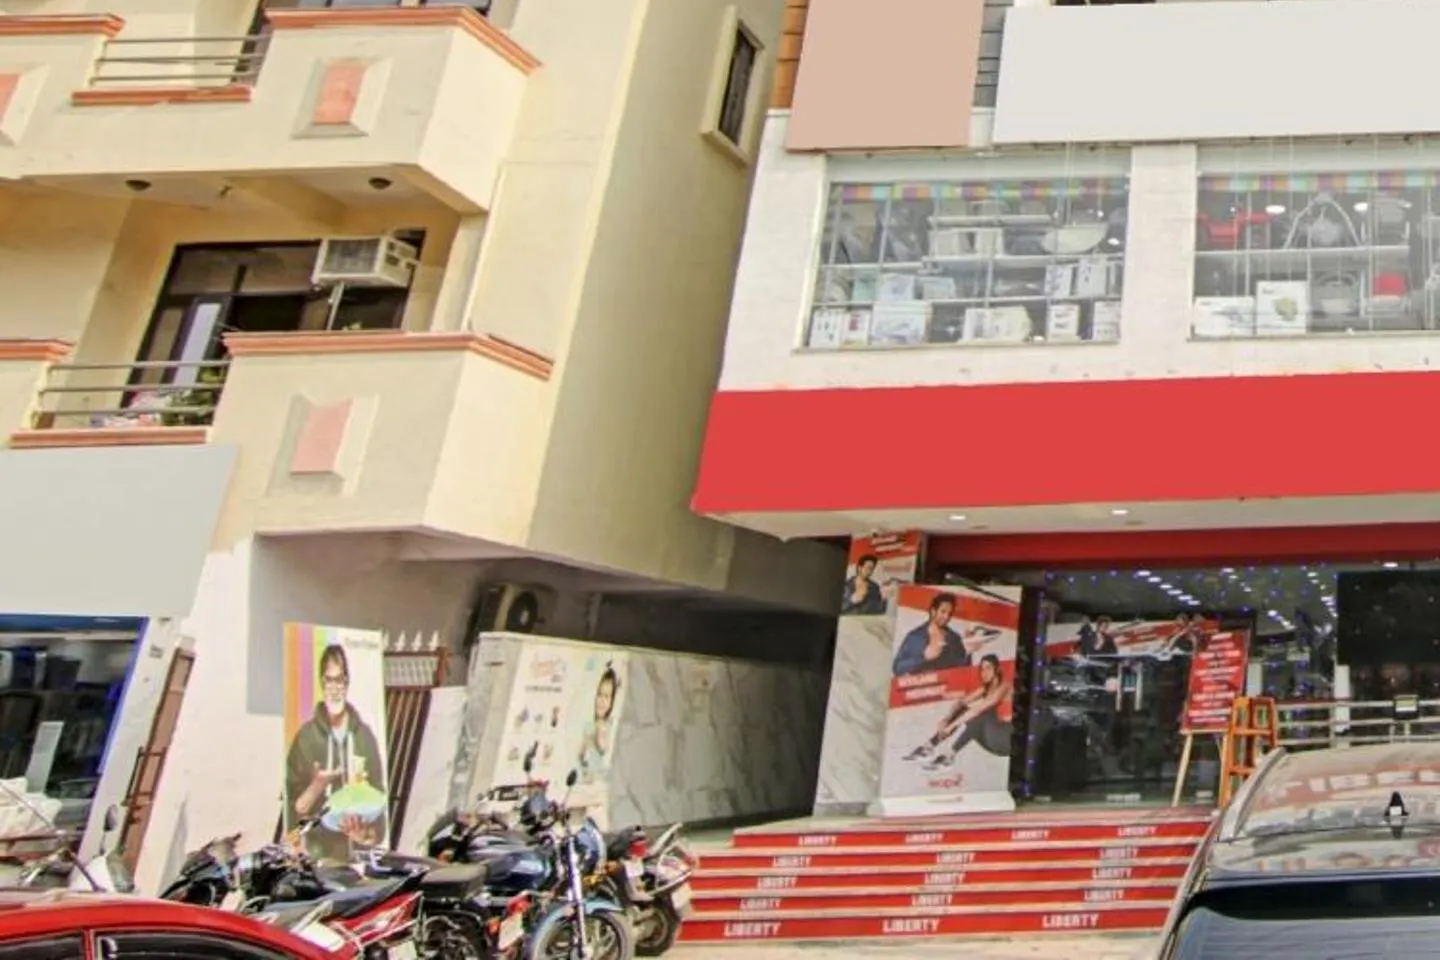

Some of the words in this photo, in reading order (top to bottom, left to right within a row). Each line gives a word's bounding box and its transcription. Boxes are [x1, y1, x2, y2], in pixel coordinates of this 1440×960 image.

[1011, 829, 1049, 840] LIBERTY
[1117, 826, 1158, 837] LIBERTY
[798, 835, 838, 846] LIBERTY
[905, 833, 944, 843] LIBERTY
[936, 852, 975, 864] LIBERTY
[1100, 847, 1139, 859] LIBERTY
[772, 856, 812, 868] LIBERTY
[924, 872, 966, 885] LIBERTY
[1092, 867, 1133, 879] LIBERTY
[757, 876, 798, 889] LIBERTY
[911, 894, 953, 906] LIBERTY
[1084, 889, 1125, 901] LIBERTY
[739, 898, 782, 910] LIBERTY
[882, 918, 940, 933] LIBERTY
[1042, 913, 1100, 928] LIBERTY
[723, 921, 782, 937] LIBERTY
